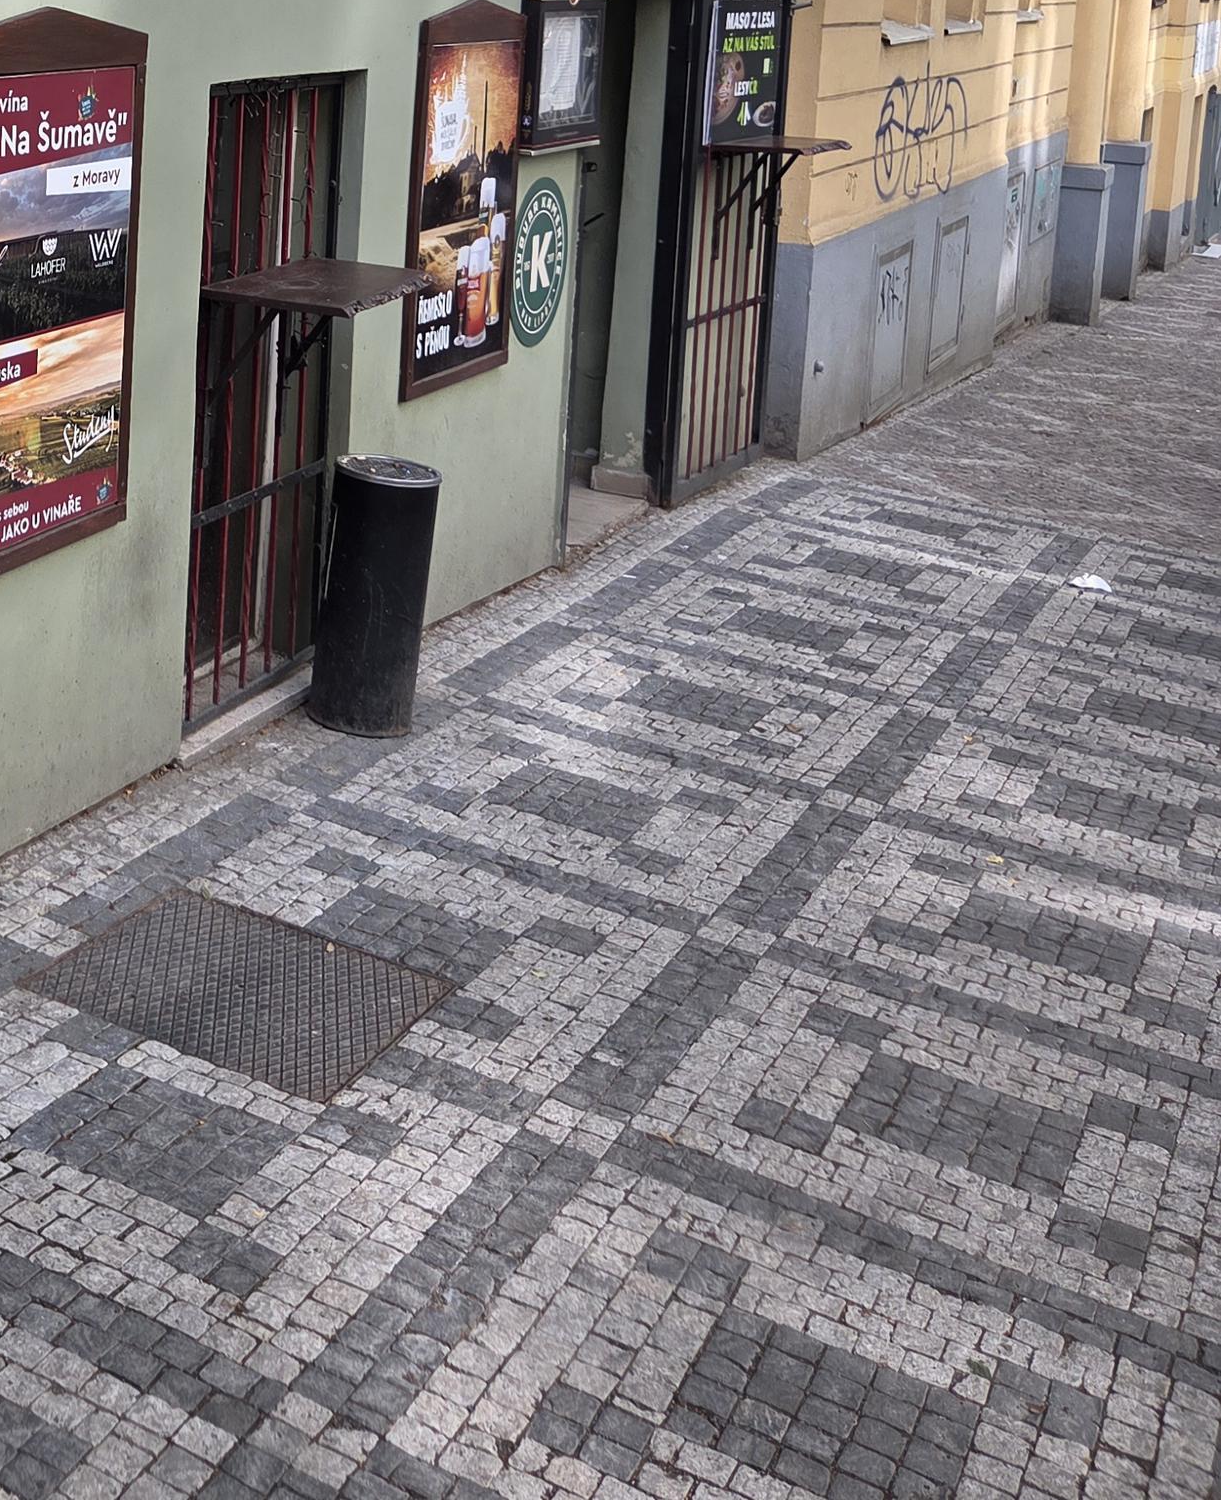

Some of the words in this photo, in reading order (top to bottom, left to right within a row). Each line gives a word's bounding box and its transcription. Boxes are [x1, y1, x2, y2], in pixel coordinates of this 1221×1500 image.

[725, 12, 750, 30] MASO
[750, 12, 757, 29] Z
[757, 11, 775, 29] LESA
[723, 33, 733, 53] AŽ
[734, 37, 744, 52] NA
[0, 89, 28, 114] vína
[37, 108, 128, 154] Šumavě"
[73, 173, 80, 188] z
[82, 166, 121, 189] Moravy
[31, 257, 66, 279] LAHOFER
[529, 230, 554, 293] K
[416, 333, 423, 359] S
[424, 325, 450, 357] PĚNOU
[1, 520, 31, 544] JAKO
[32, 513, 41, 530] U
[42, 495, 82, 527] VINAŘE
[3, 501, 30, 520] sebou
